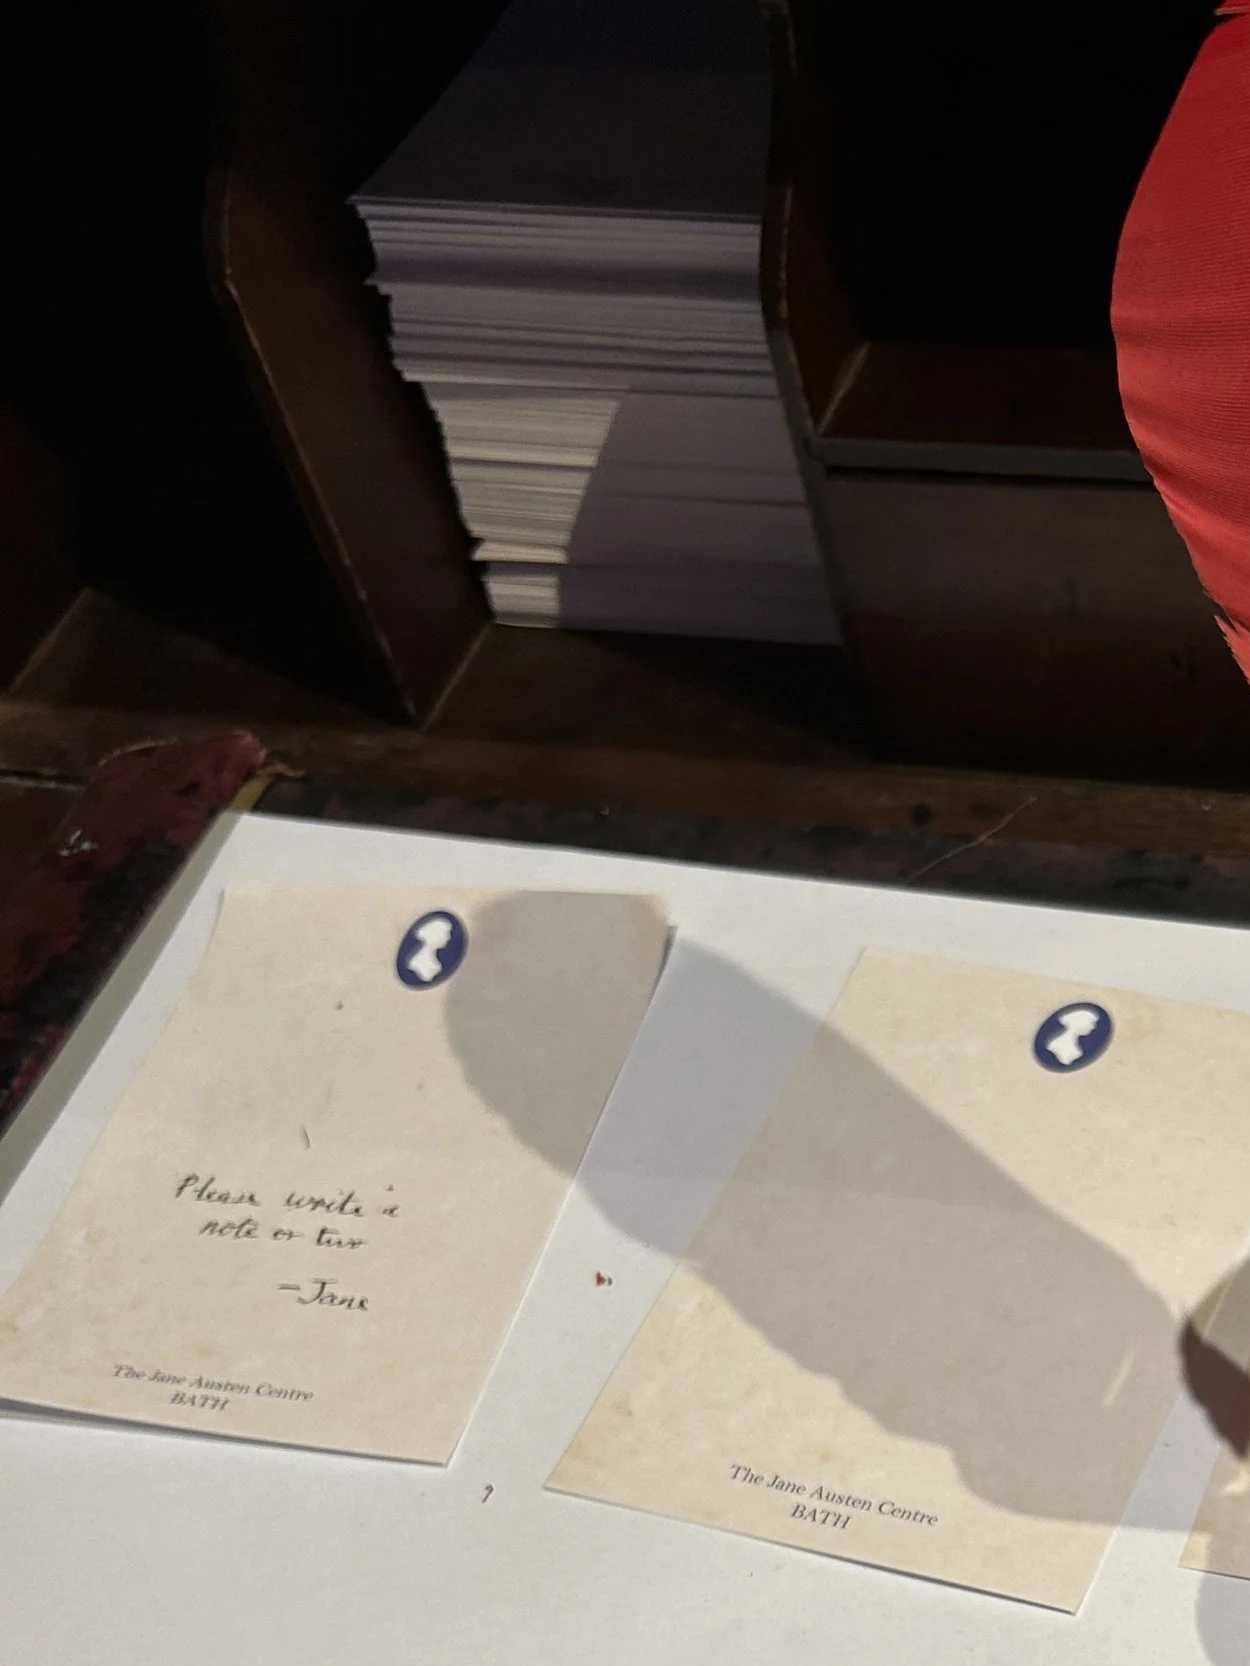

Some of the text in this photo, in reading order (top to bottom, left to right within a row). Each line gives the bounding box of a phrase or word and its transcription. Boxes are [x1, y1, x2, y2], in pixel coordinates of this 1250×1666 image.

[200, 1217, 260, 1239] note
[272, 1229, 304, 1241] or
[111, 1362, 314, 1402] The Jane Austen Centre
[170, 1390, 231, 1412] BATH
[730, 1464, 939, 1527] The Jane Austen Centre
[789, 1504, 850, 1530] BATH
